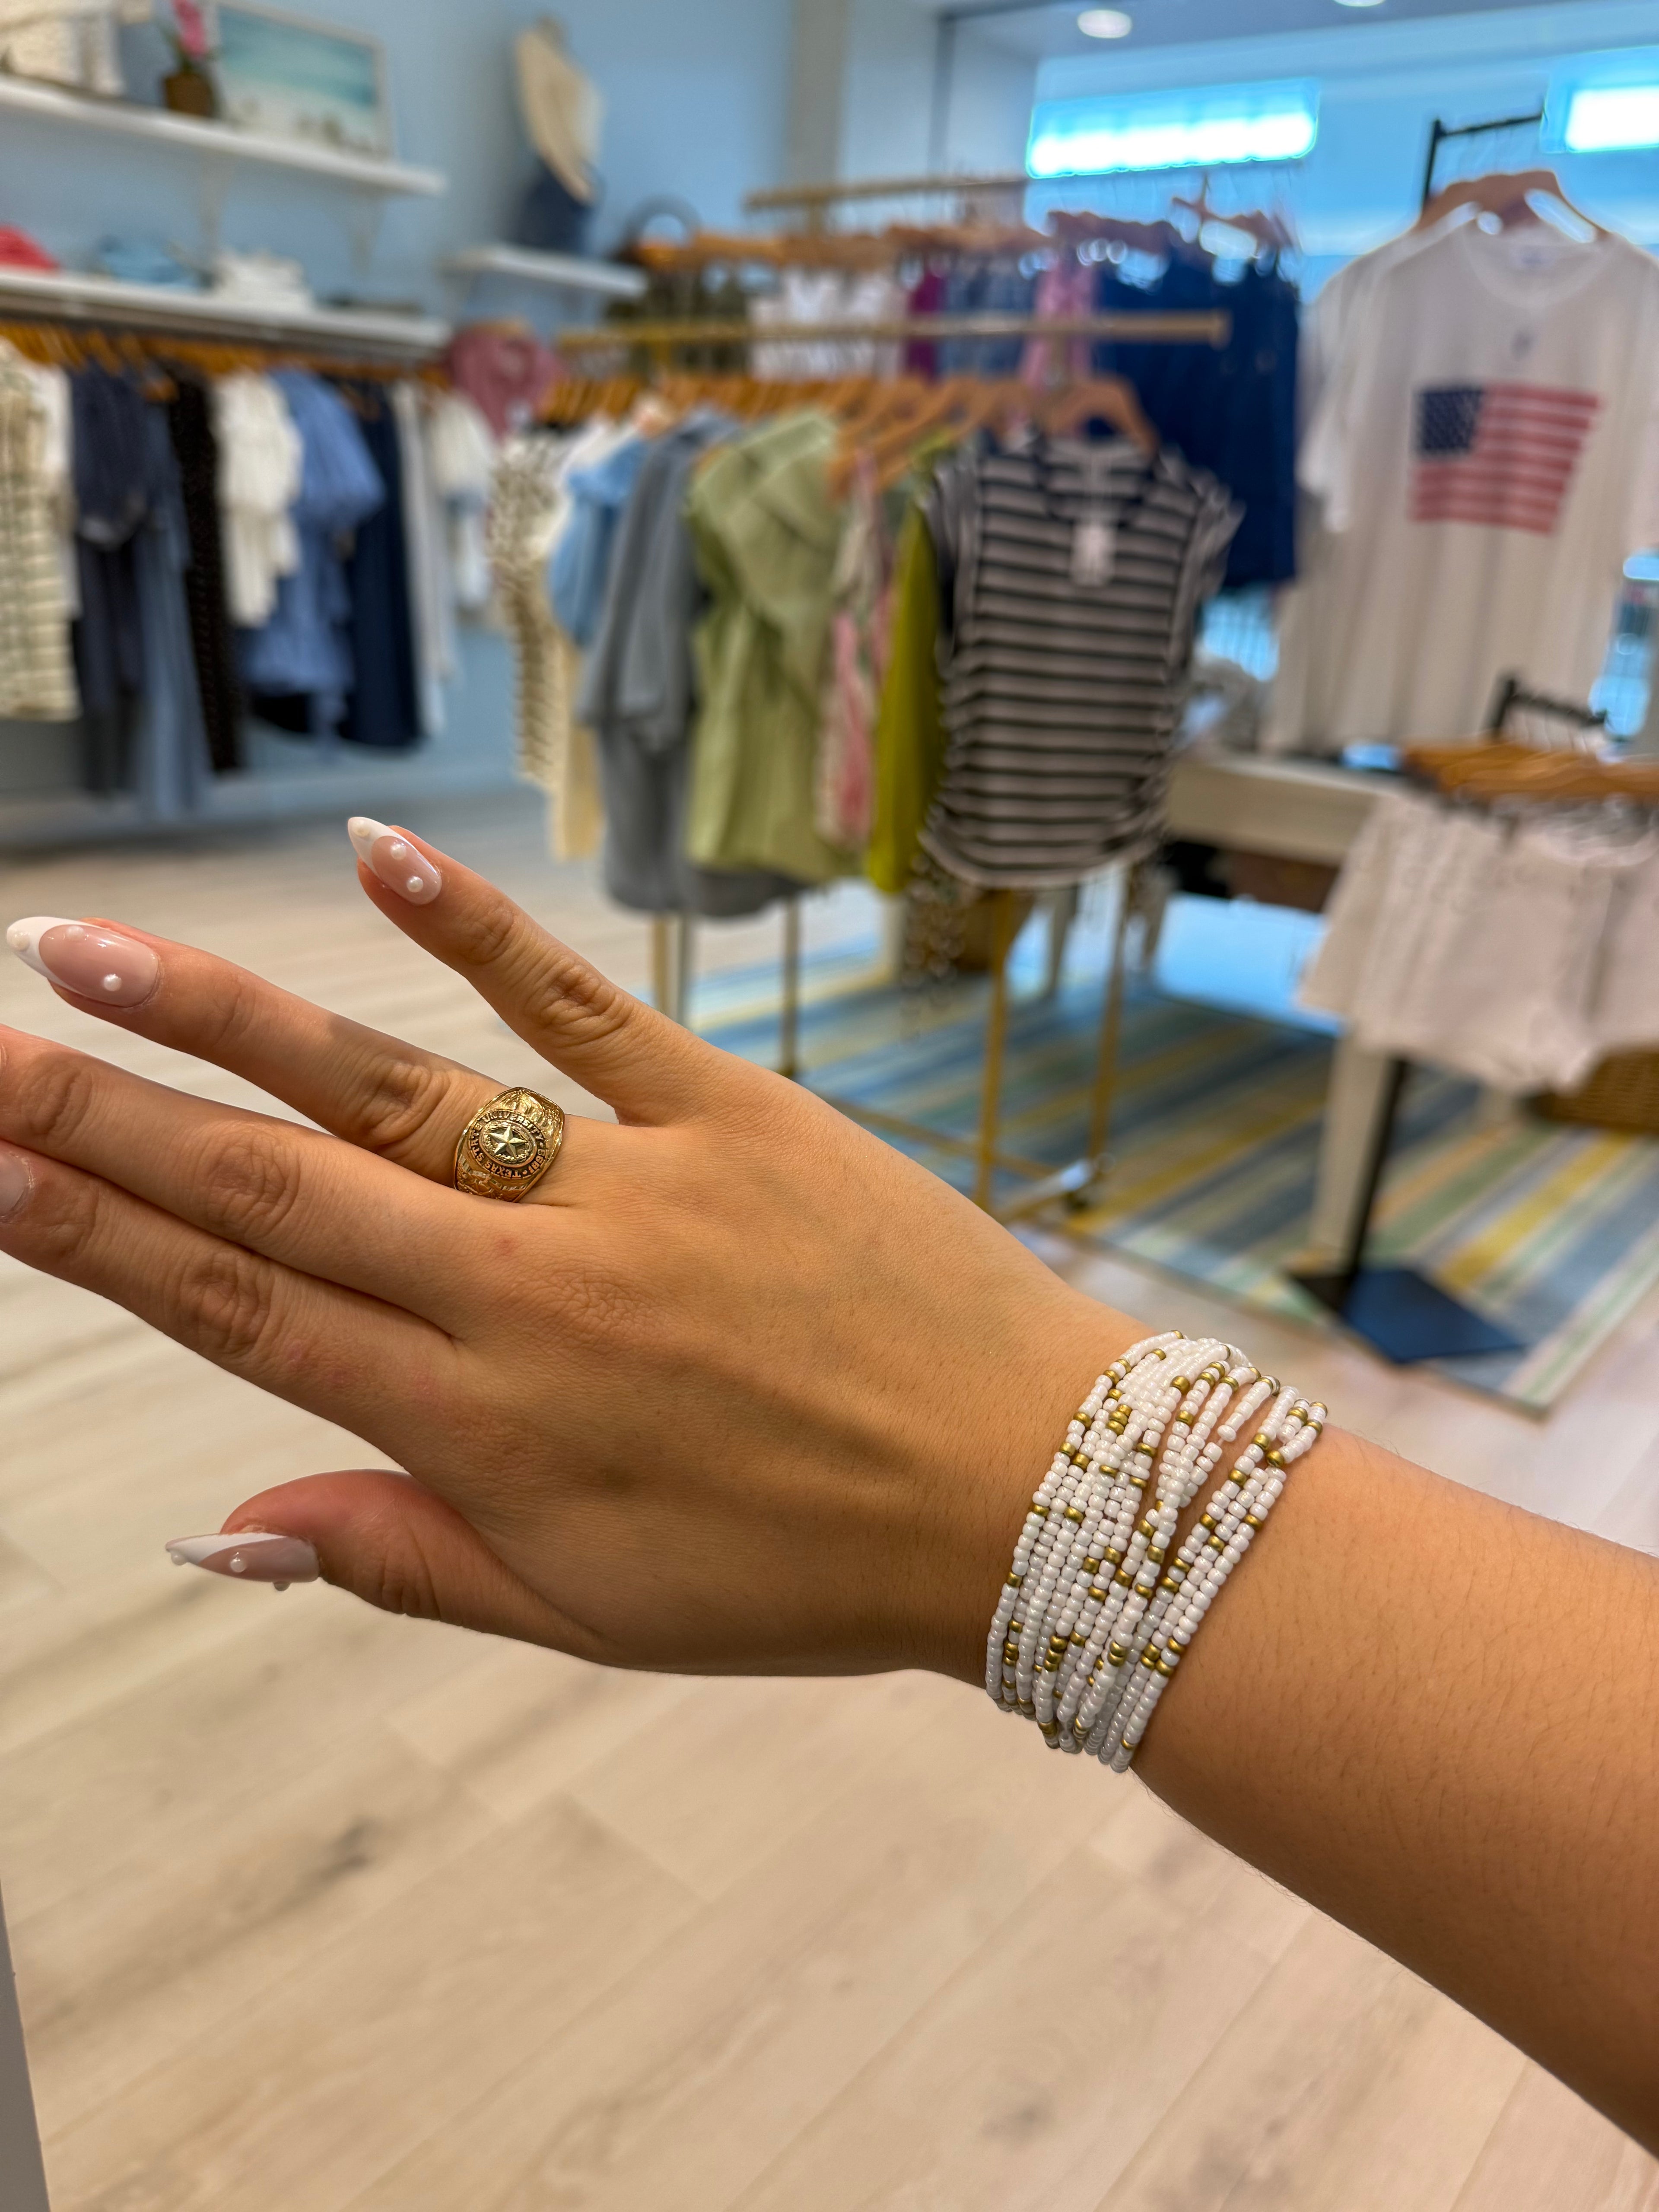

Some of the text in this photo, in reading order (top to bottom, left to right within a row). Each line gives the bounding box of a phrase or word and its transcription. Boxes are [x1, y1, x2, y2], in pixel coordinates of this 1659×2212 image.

[471, 1111, 544, 1178] TEXAS STATE UNIVERSITY
[528, 1149, 545, 1173] 1899
